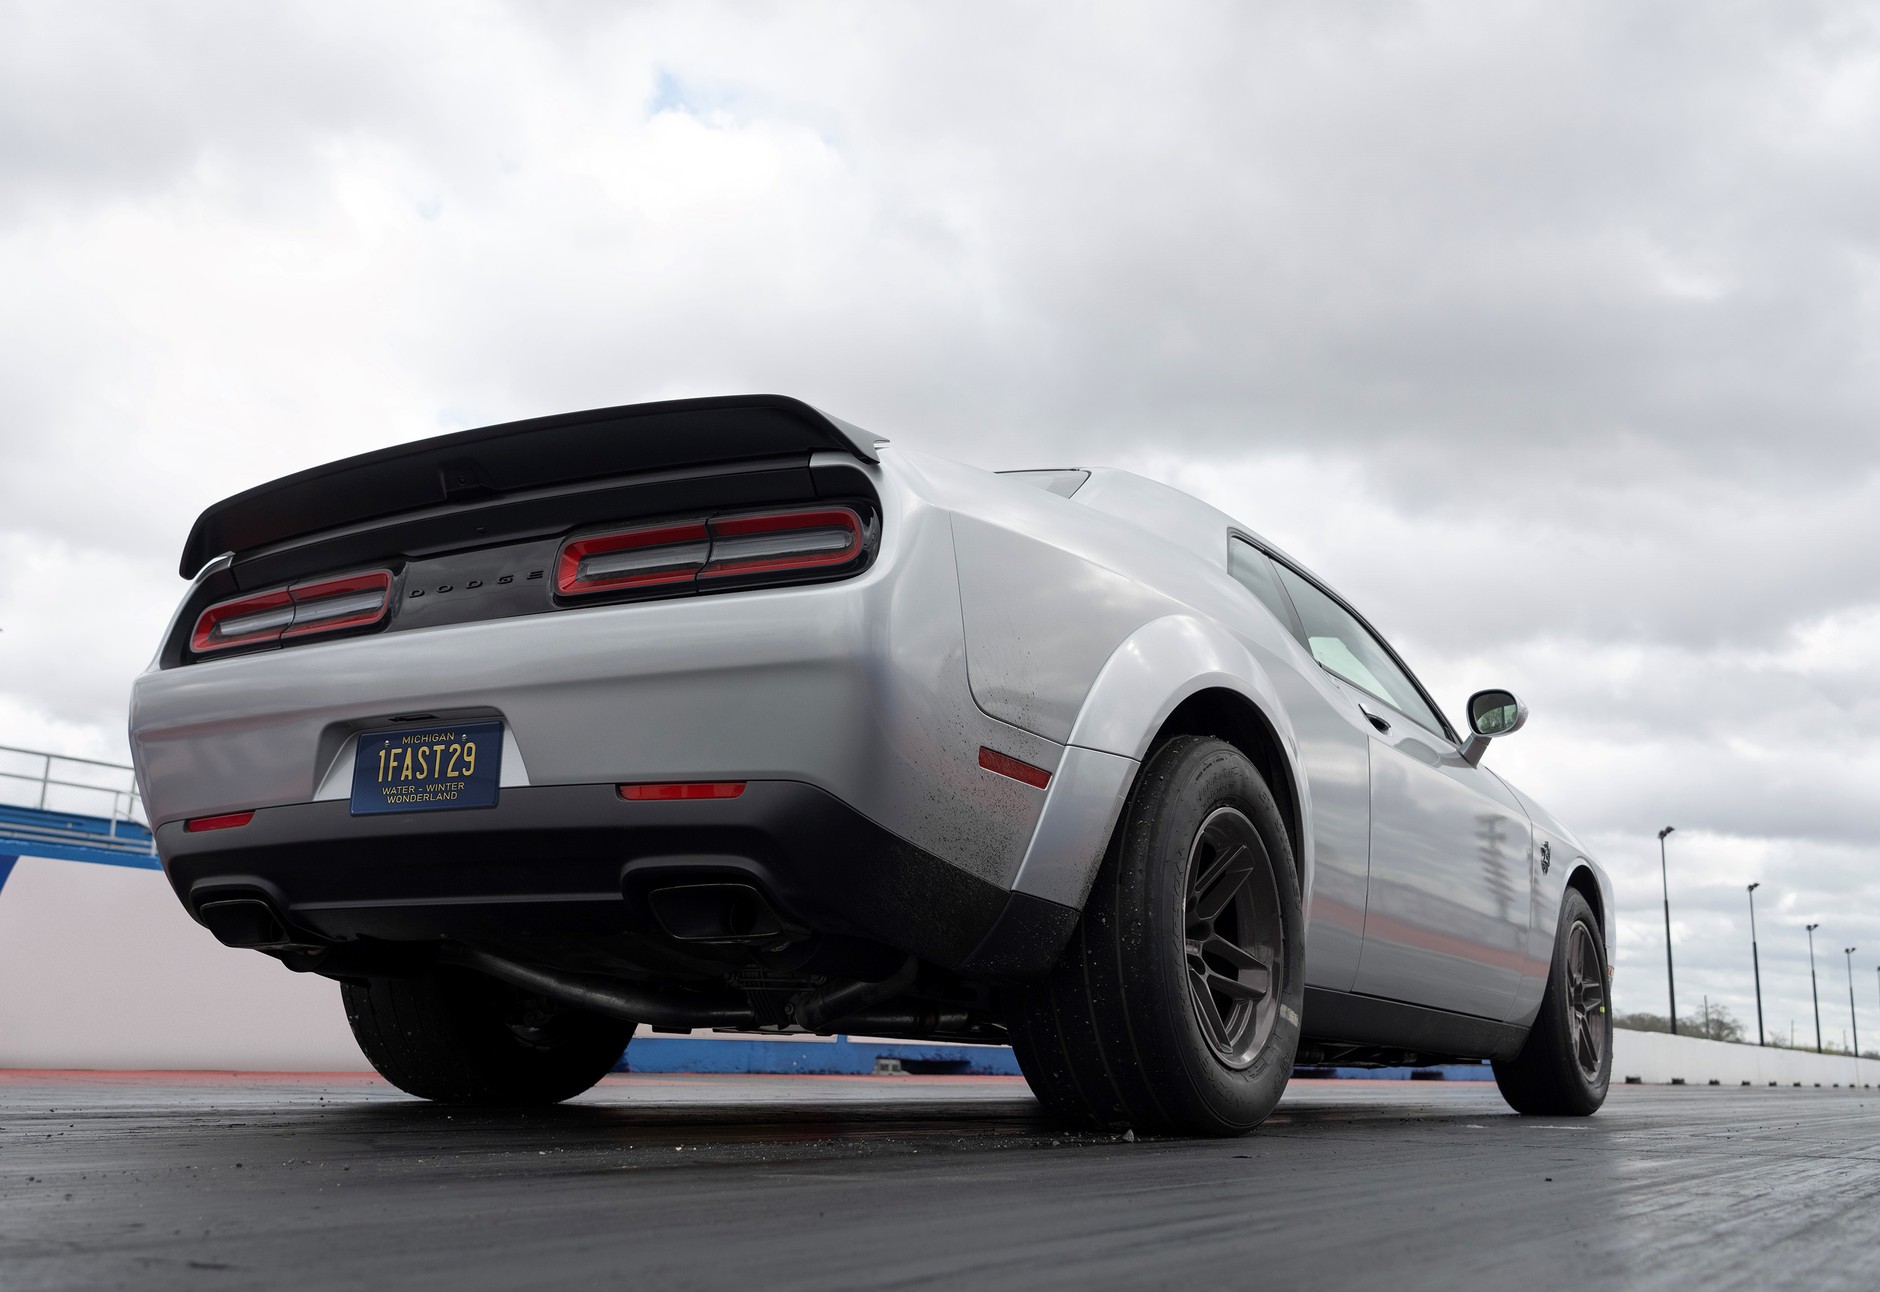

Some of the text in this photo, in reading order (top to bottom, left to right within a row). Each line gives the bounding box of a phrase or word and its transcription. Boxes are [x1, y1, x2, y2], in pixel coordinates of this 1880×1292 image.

[409, 570, 544, 598] DODGE
[402, 732, 455, 744] MICHIGAN
[378, 742, 477, 782] 1FAST29
[382, 785, 415, 795] WATER
[425, 782, 465, 793] WINTER
[387, 791, 458, 803] WONDERLAND
